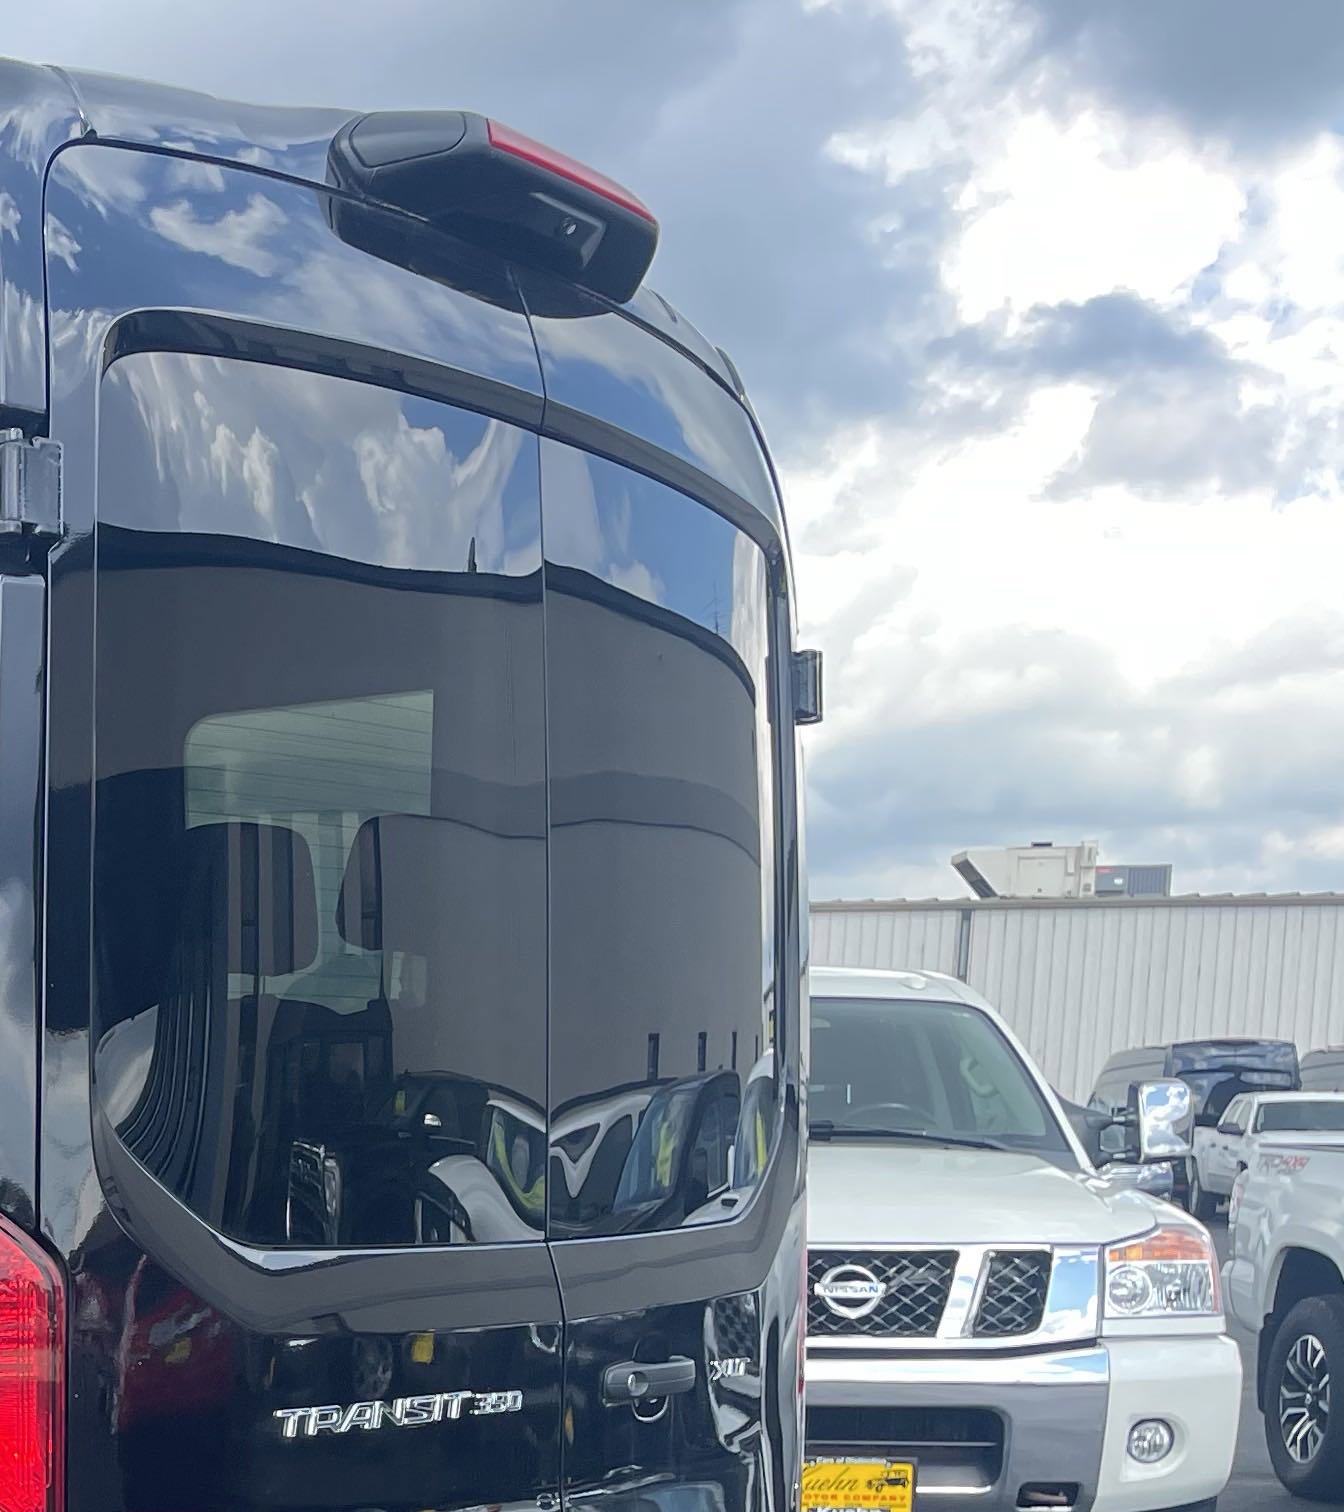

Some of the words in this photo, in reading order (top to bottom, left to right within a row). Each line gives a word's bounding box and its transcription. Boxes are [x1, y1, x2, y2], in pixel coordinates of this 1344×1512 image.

[823, 1286, 879, 1294] NISSAN
[709, 1357, 751, 1381] XLT
[273, 1390, 472, 1437] TRANSIT
[468, 1390, 523, 1415] 350
[803, 1493, 838, 1501] OTOR
[843, 1493, 906, 1501] COMPANY
